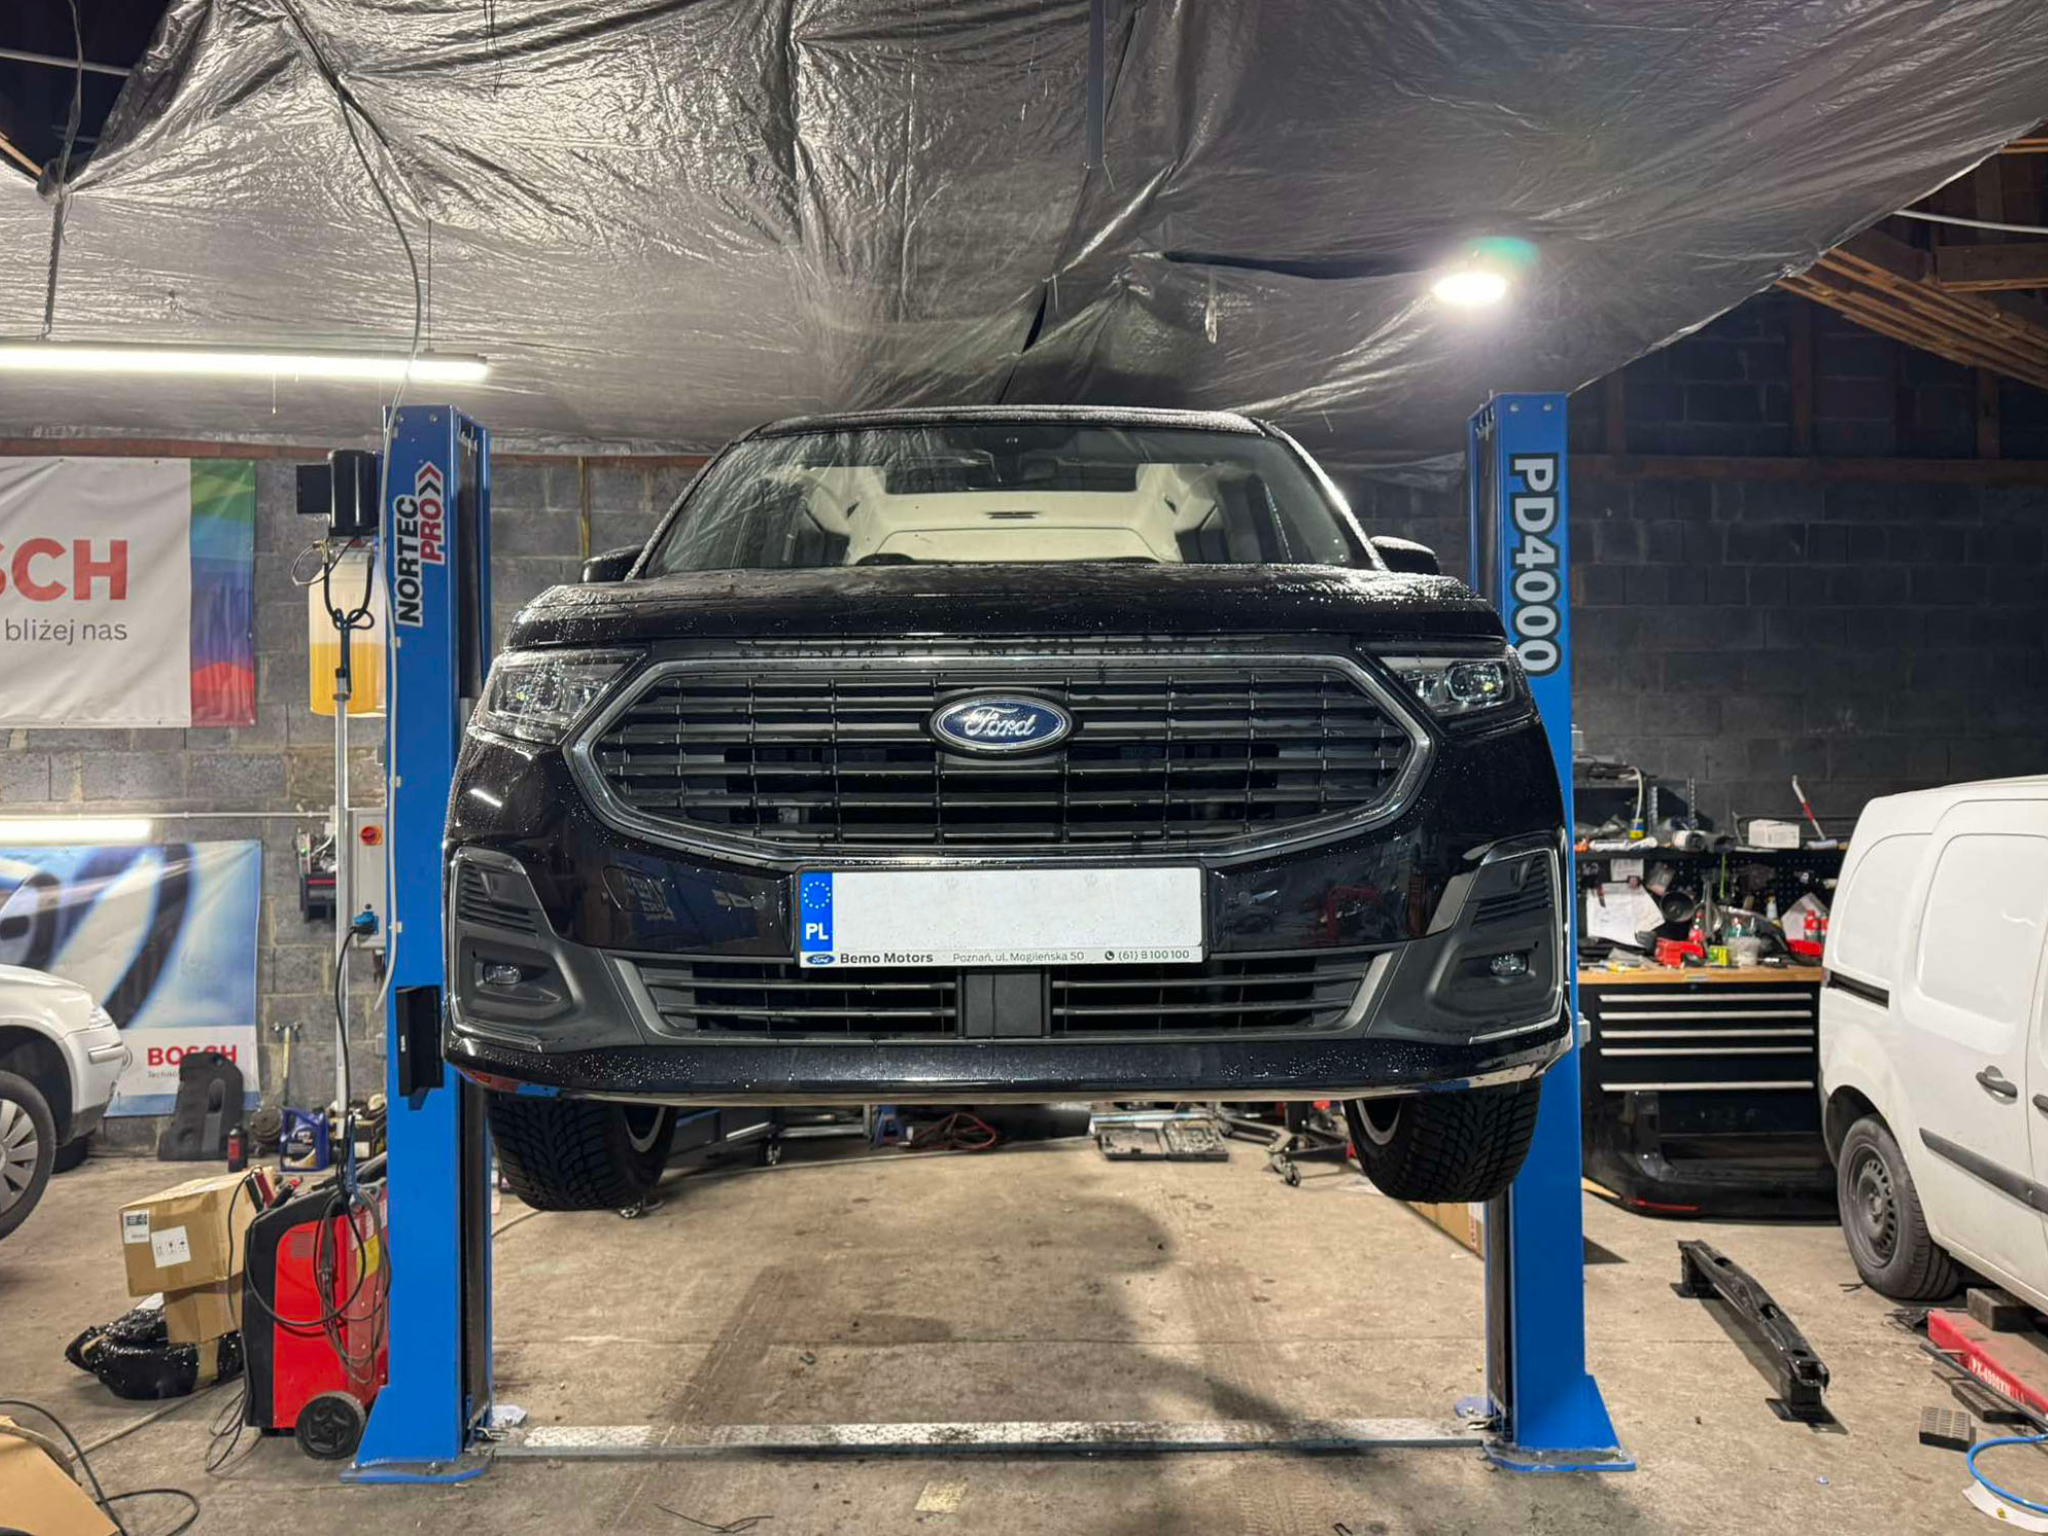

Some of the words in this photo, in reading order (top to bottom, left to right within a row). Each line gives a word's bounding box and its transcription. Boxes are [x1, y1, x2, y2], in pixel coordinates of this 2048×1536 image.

[419, 497, 443, 562] PRO
[0, 538, 128, 602] CH
[396, 496, 421, 624] NORTEC
[1512, 456, 1559, 675] PD4000
[5, 617, 75, 646] bliżej
[82, 623, 128, 641] nas
[964, 705, 1037, 738] Ford
[805, 922, 829, 940] PL
[840, 953, 880, 964] Bemo
[883, 952, 934, 963] Motors
[953, 953, 994, 963] Poznań,
[1070, 951, 1085, 961] 50
[1118, 950, 1138, 961] (61)
